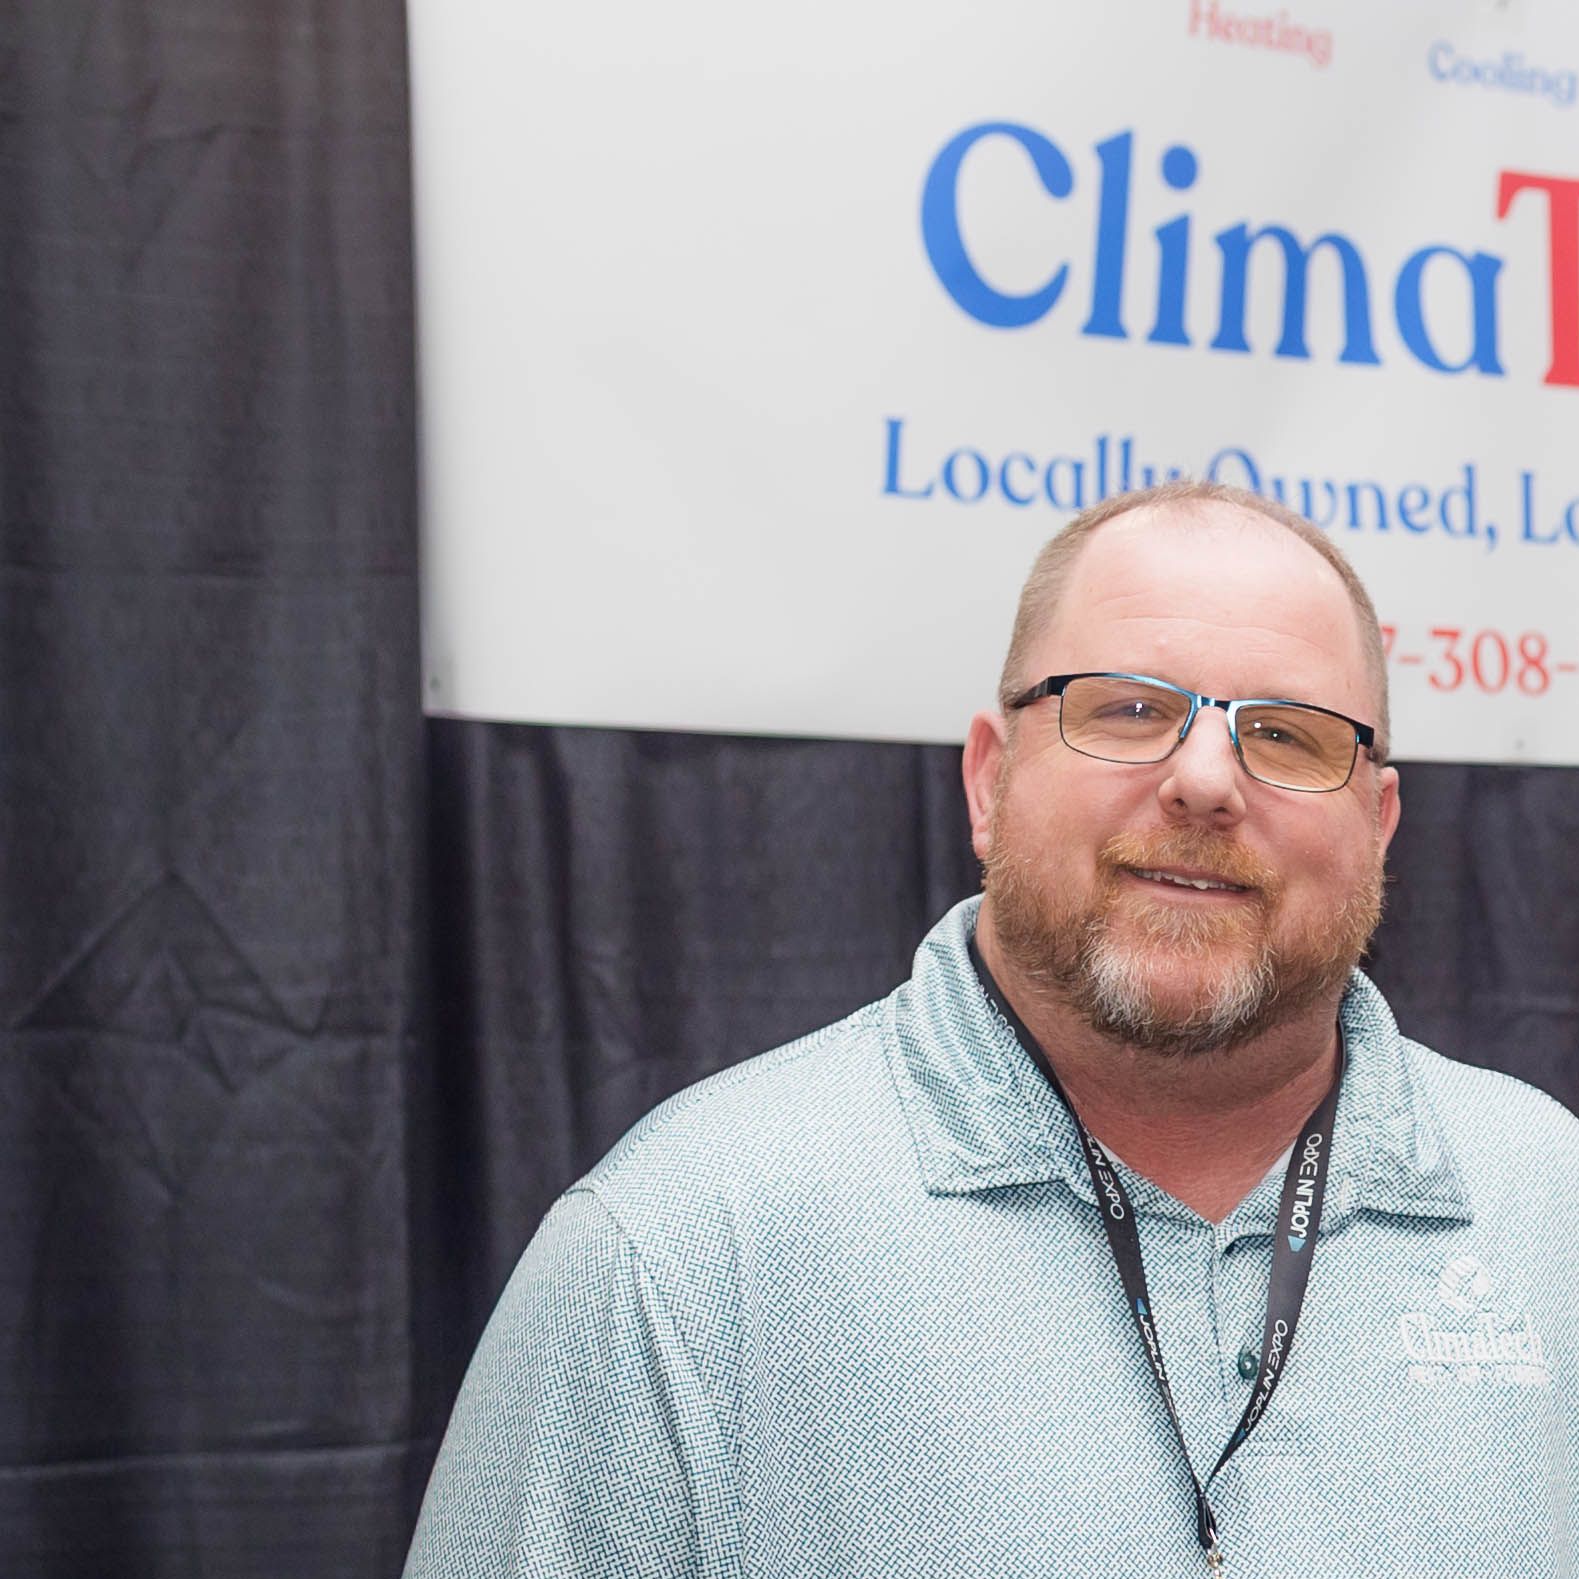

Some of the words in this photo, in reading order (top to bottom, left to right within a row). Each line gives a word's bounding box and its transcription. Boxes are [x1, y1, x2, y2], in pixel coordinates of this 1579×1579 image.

[1188, 0, 1333, 68] Heating
[1428, 40, 1579, 108] Cooling
[1299, 1133, 1323, 1177] EXPO
[1098, 1169, 1125, 1220] EXPO
[1290, 1179, 1315, 1239] JOPLIN
[1140, 1315, 1166, 1381] JOPLIN
[1400, 1311, 1545, 1364] ClimaTech
[1244, 1369, 1277, 1433] JOPLIN
[1267, 1318, 1290, 1371] EXPO
